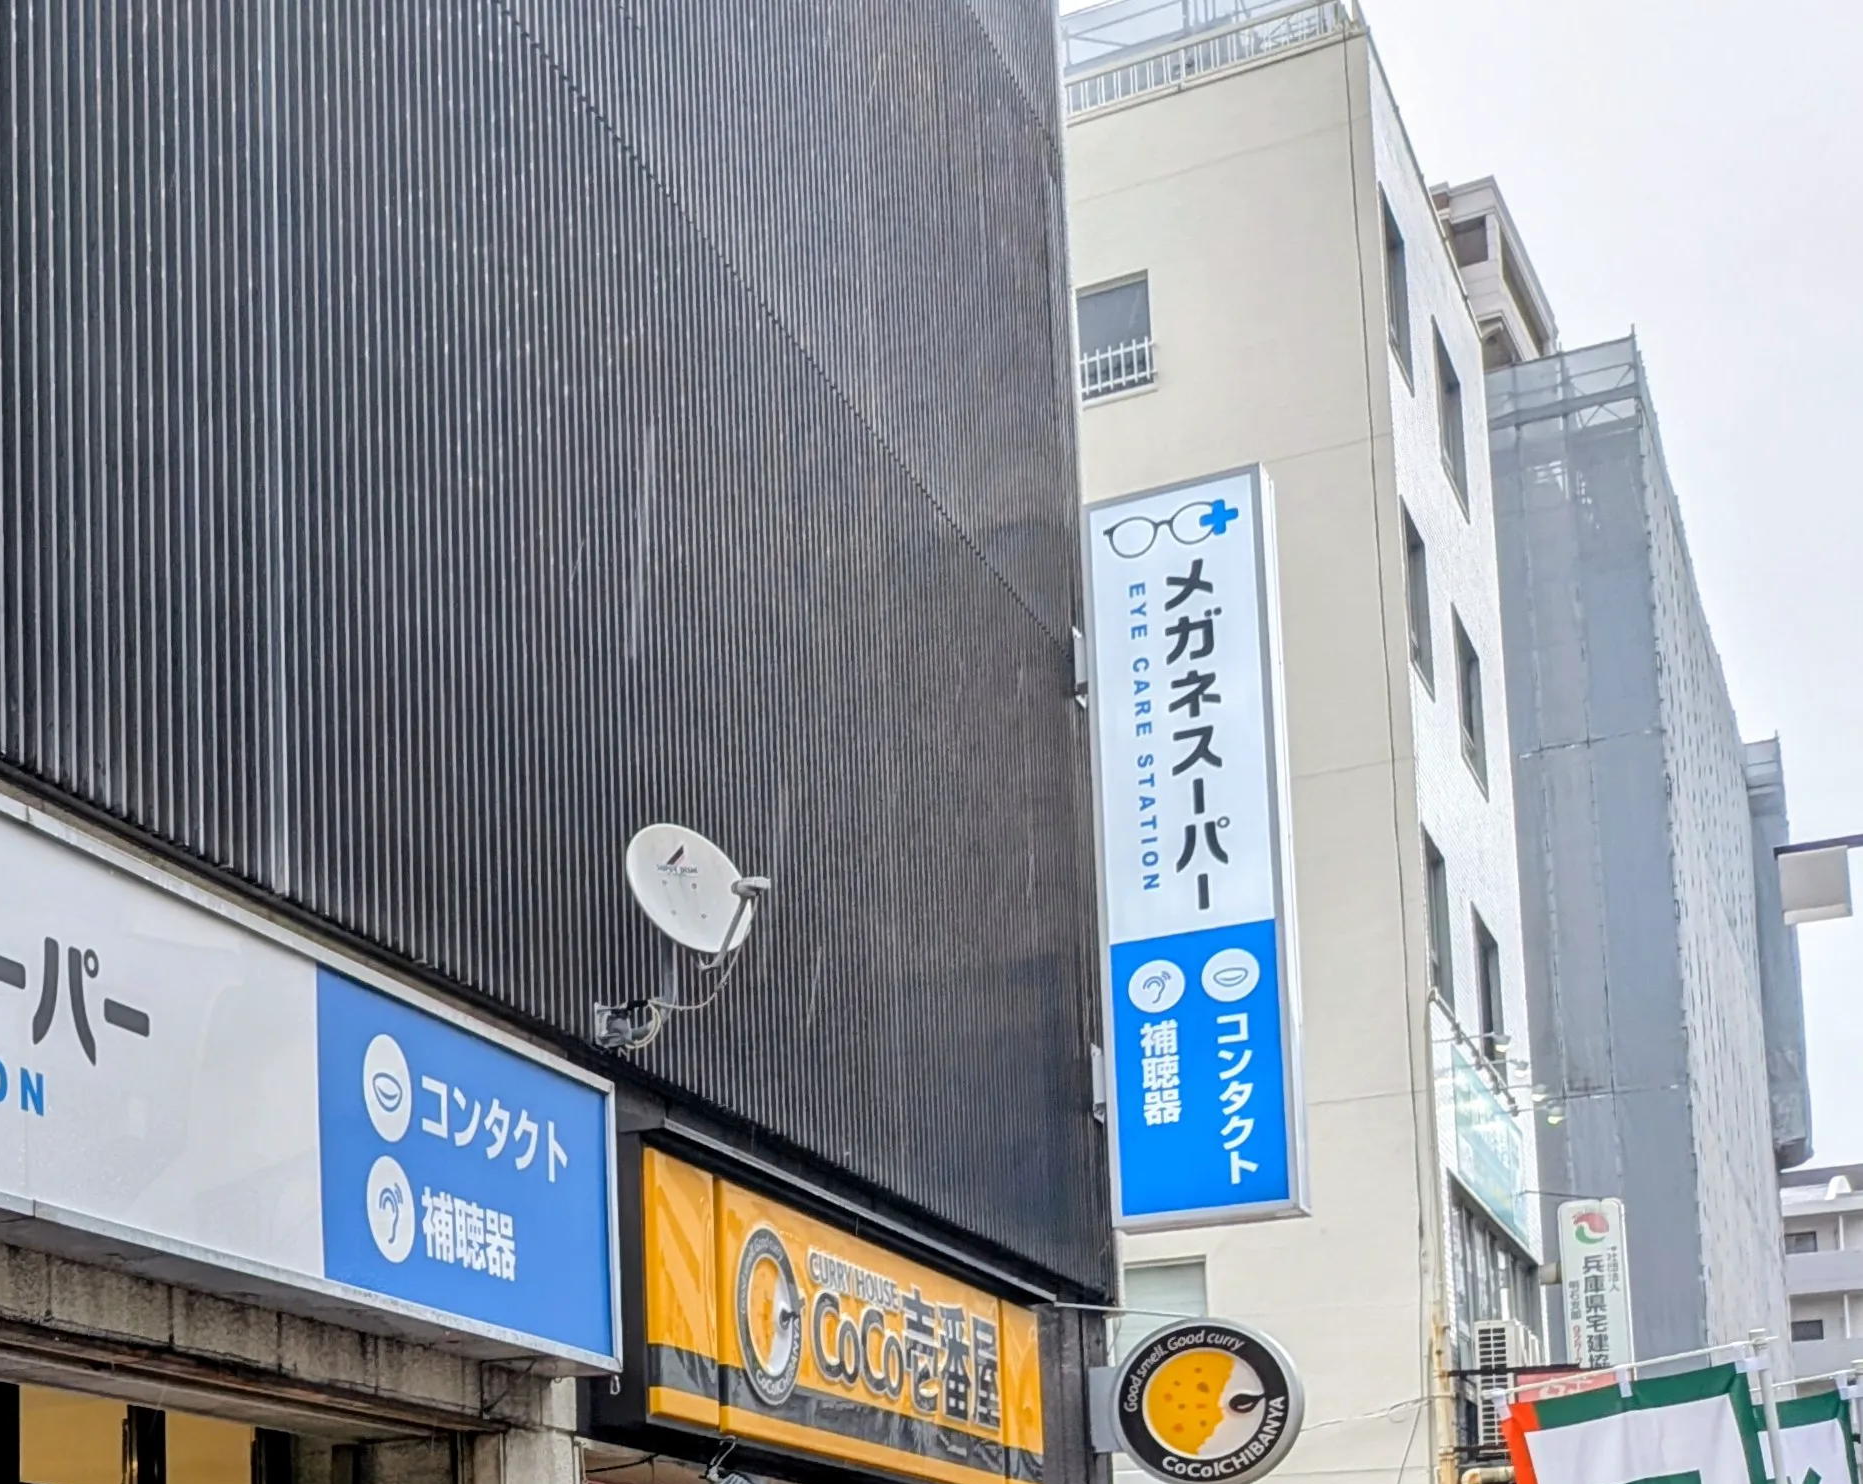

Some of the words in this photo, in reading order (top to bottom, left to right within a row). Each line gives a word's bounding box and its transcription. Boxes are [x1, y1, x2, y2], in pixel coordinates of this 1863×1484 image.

[1127, 581, 1148, 639] EYE
[1131, 656, 1153, 737] CARE
[1163, 557, 1232, 912] メガネスーパー
[1136, 753, 1160, 892] STATION
[1140, 1020, 1182, 1126] 補聴器
[1215, 1013, 1260, 1186] コンタクト
[421, 1075, 568, 1183] コンタクト
[422, 1186, 516, 1281] 補聴器
[809, 1249, 855, 1295] CURRY
[856, 1264, 901, 1311] HOUSE
[813, 1284, 1000, 1431] CoCo壱番屋
[1124, 1373, 1141, 1413] Good
[1137, 1346, 1168, 1378] smell.
[1168, 1330, 1206, 1350] Good
[1206, 1333, 1246, 1351] curry
[1162, 1396, 1286, 1478] CoCoICHIBANYA
